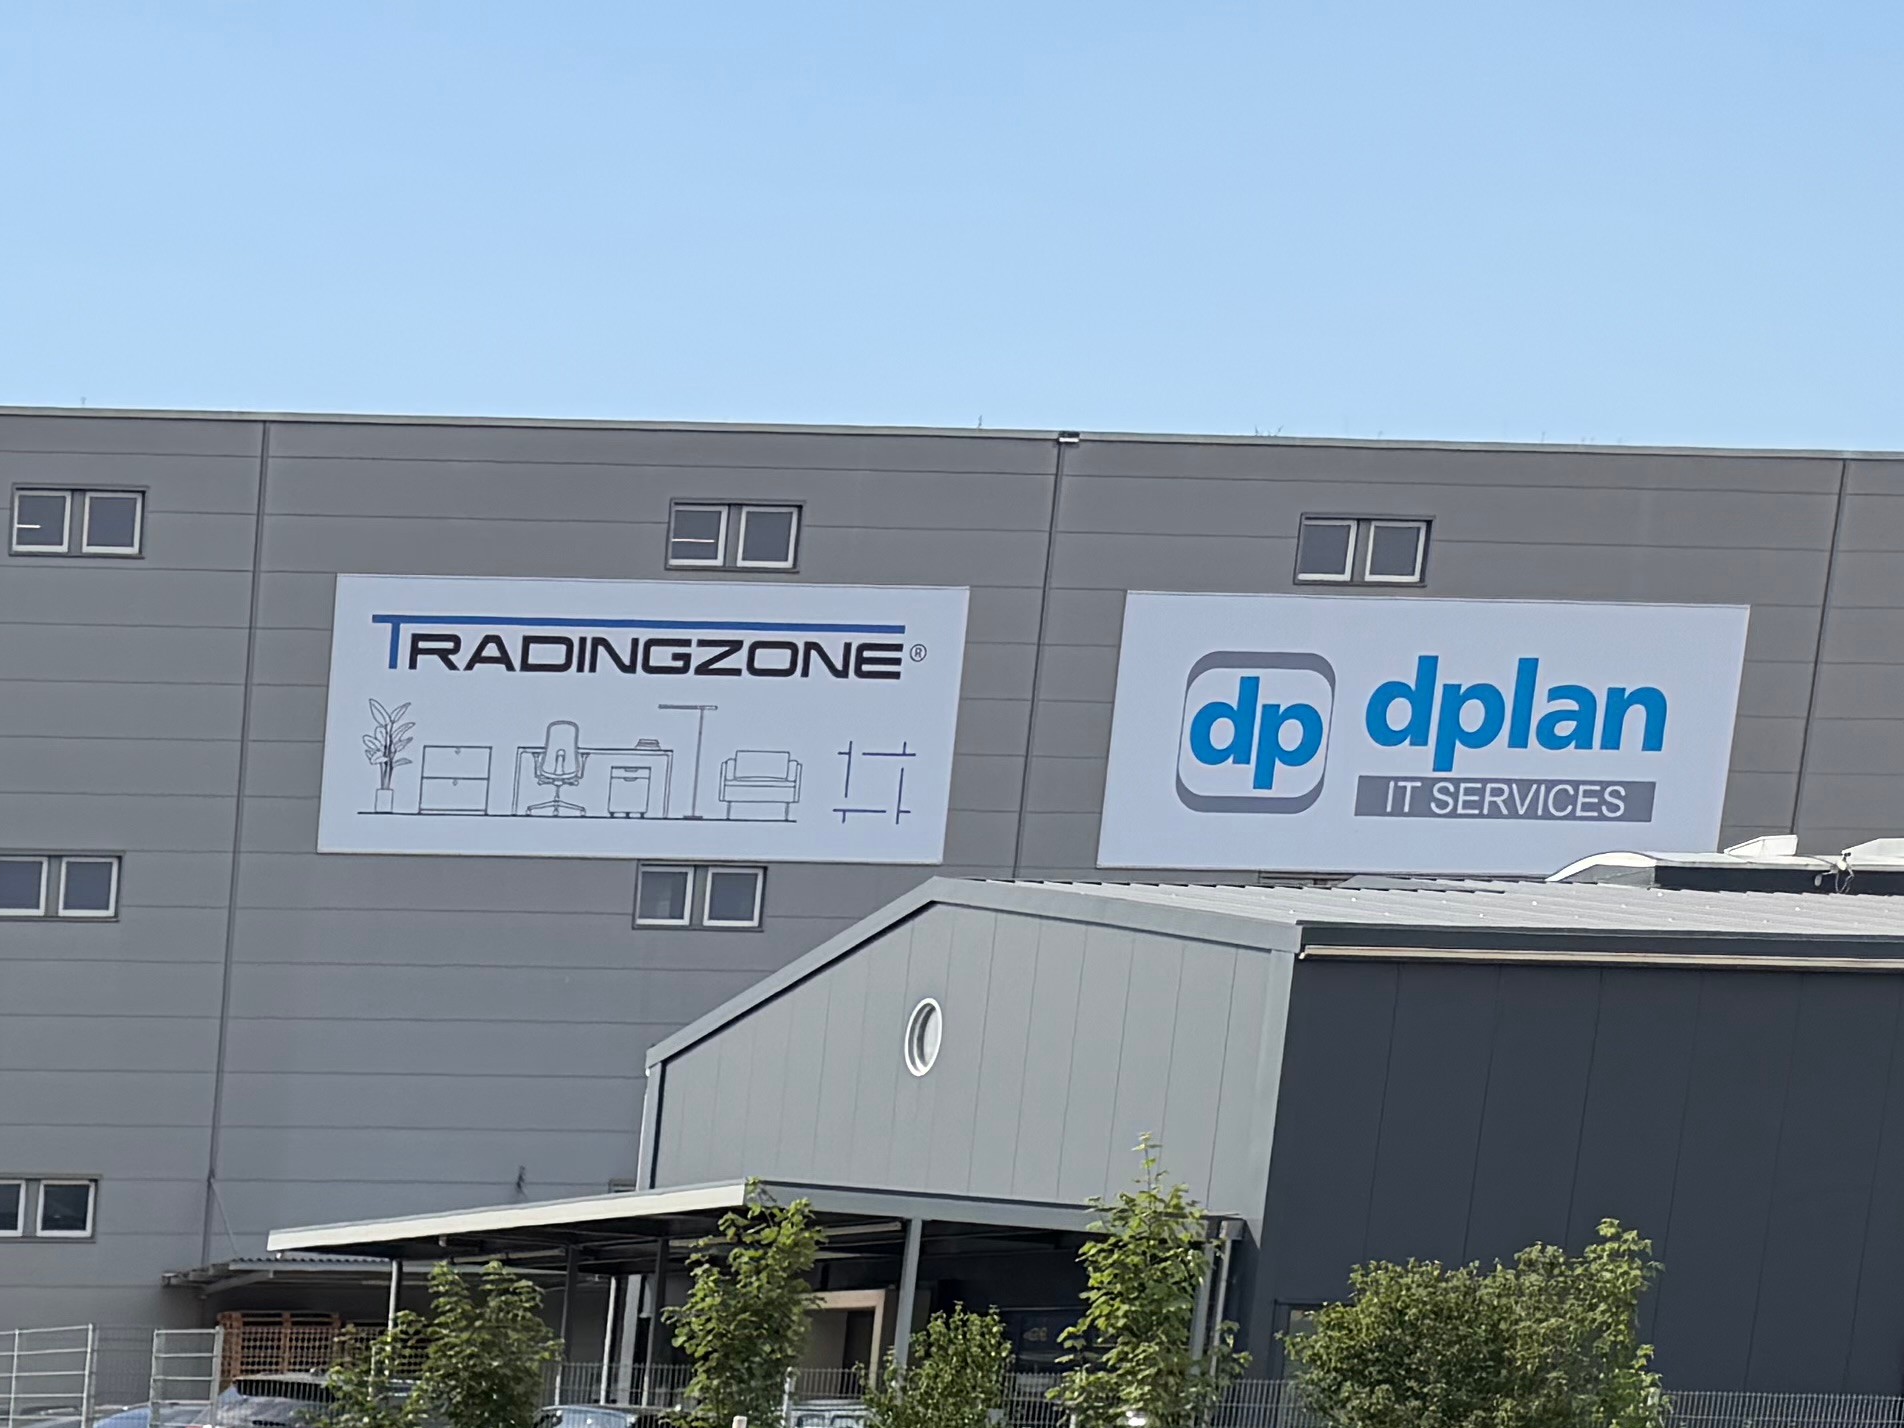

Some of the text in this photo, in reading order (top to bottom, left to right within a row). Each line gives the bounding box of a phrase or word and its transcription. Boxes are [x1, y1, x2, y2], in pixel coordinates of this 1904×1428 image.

[1189, 676, 1324, 790] dp
[1365, 654, 1668, 773] dplan
[1385, 780, 1626, 817] IT SERVICES
